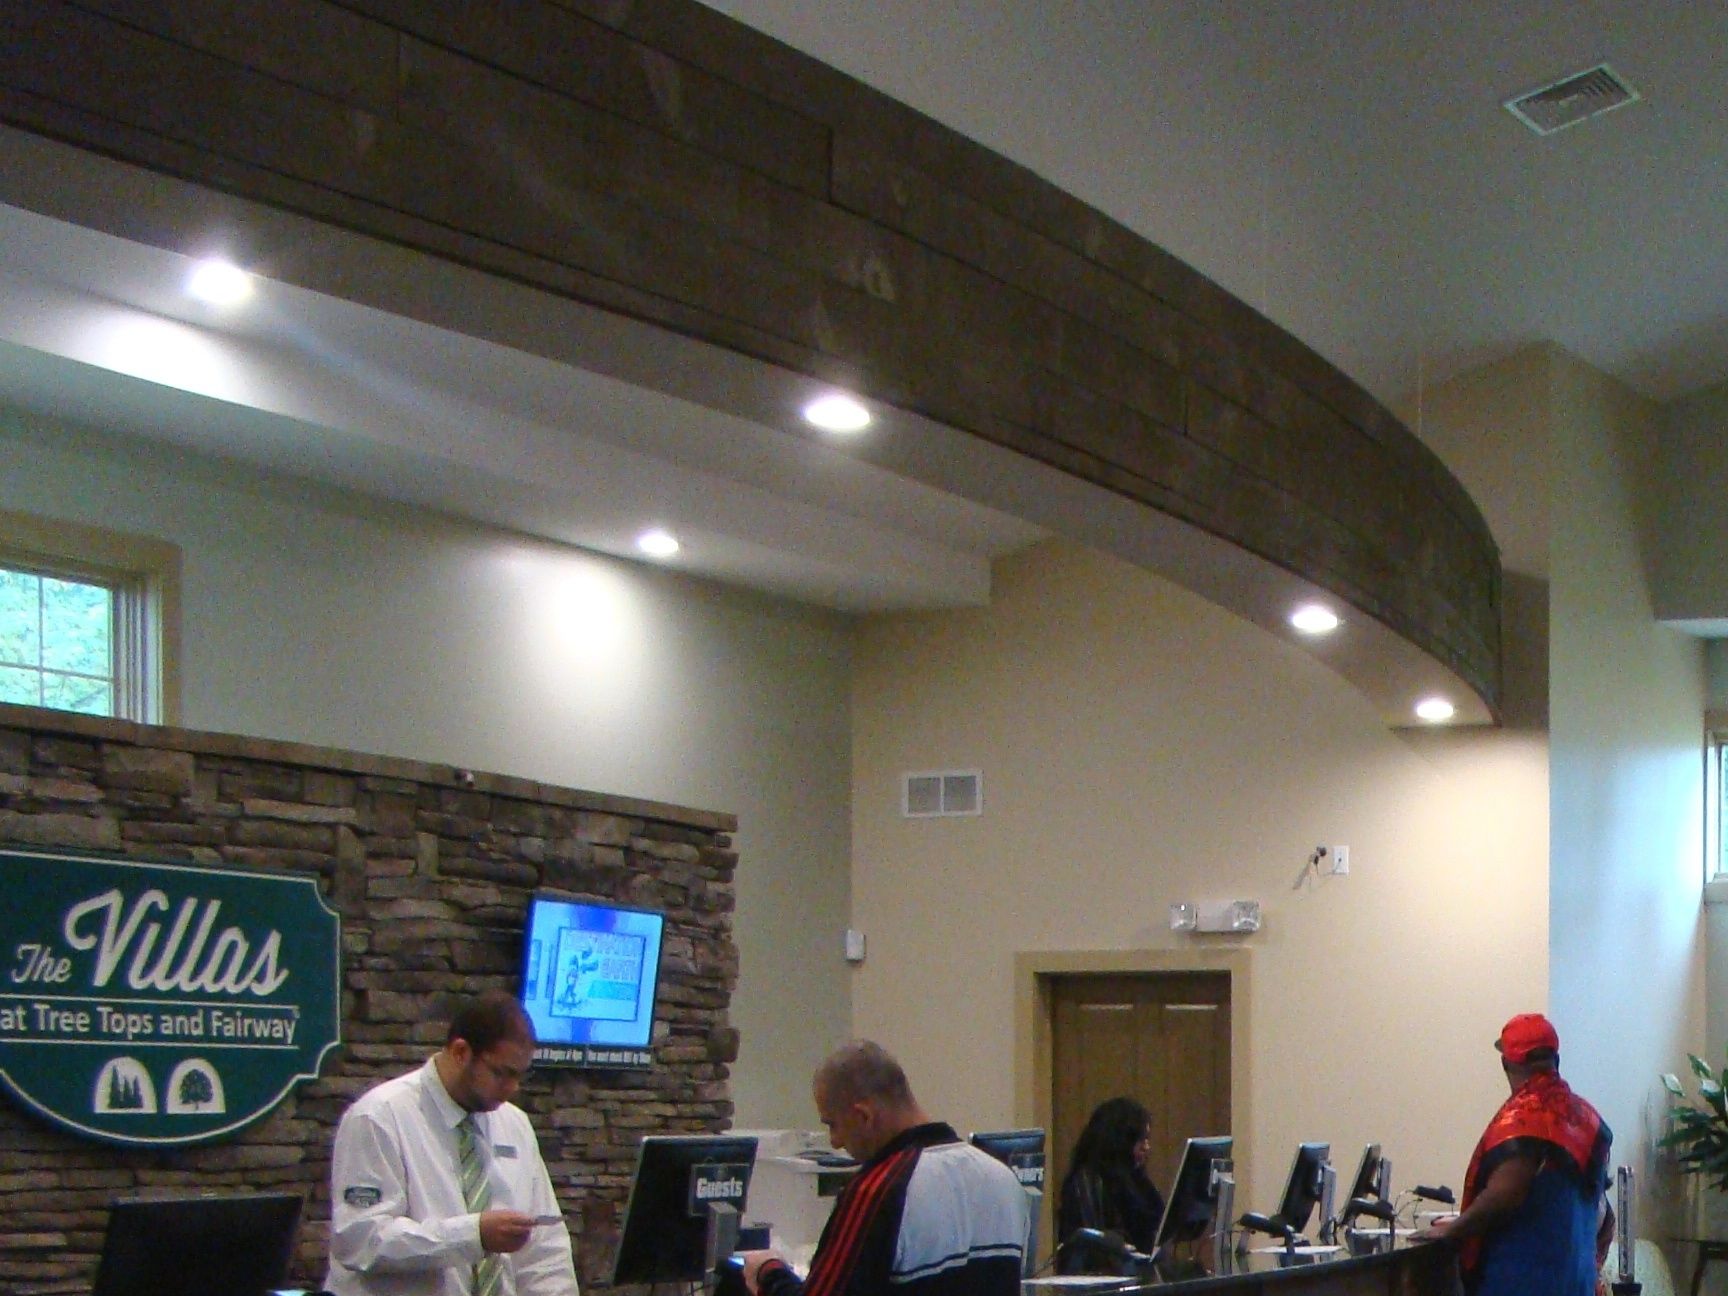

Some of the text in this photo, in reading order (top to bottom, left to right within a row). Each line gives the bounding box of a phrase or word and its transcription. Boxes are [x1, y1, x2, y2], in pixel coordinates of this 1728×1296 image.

[11, 889, 289, 996] The Villas
[0, 1003, 297, 1044] at Tree Tops and Fairway
[696, 1177, 743, 1198] Guests
